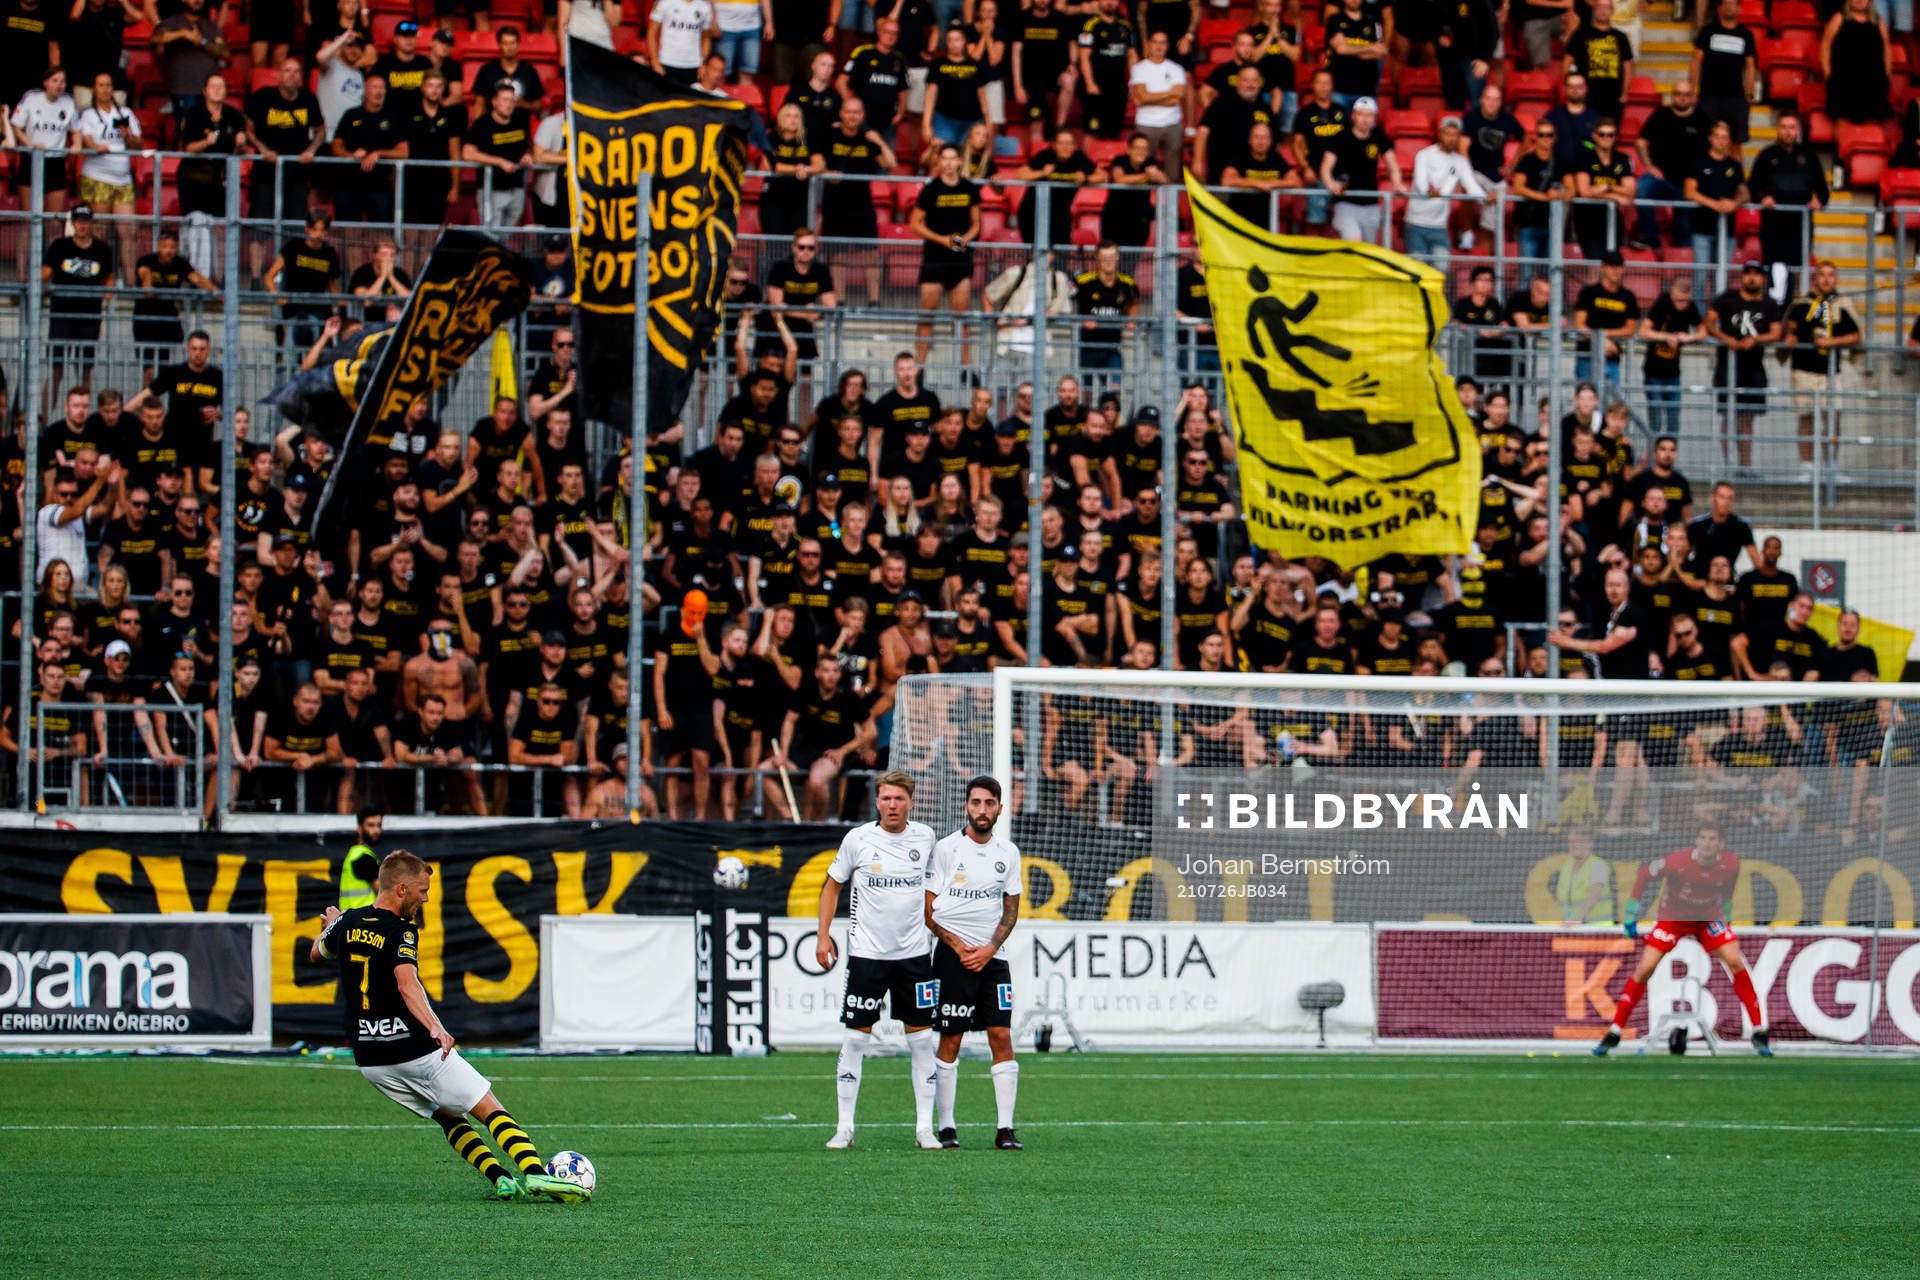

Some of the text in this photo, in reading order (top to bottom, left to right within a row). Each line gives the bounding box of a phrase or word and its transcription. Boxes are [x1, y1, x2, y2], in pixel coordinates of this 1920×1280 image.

[346, 929, 386, 950] LARSSON
[1032, 934, 1217, 979] MEDIA
[350, 953, 370, 1011] 7
[696, 909, 713, 1053] SELECT
[726, 908, 764, 1052] SELECT
[0, 1011, 190, 1032] ERIBUTIKEN ÖREBRO
[358, 1016, 409, 1036] SVEA
